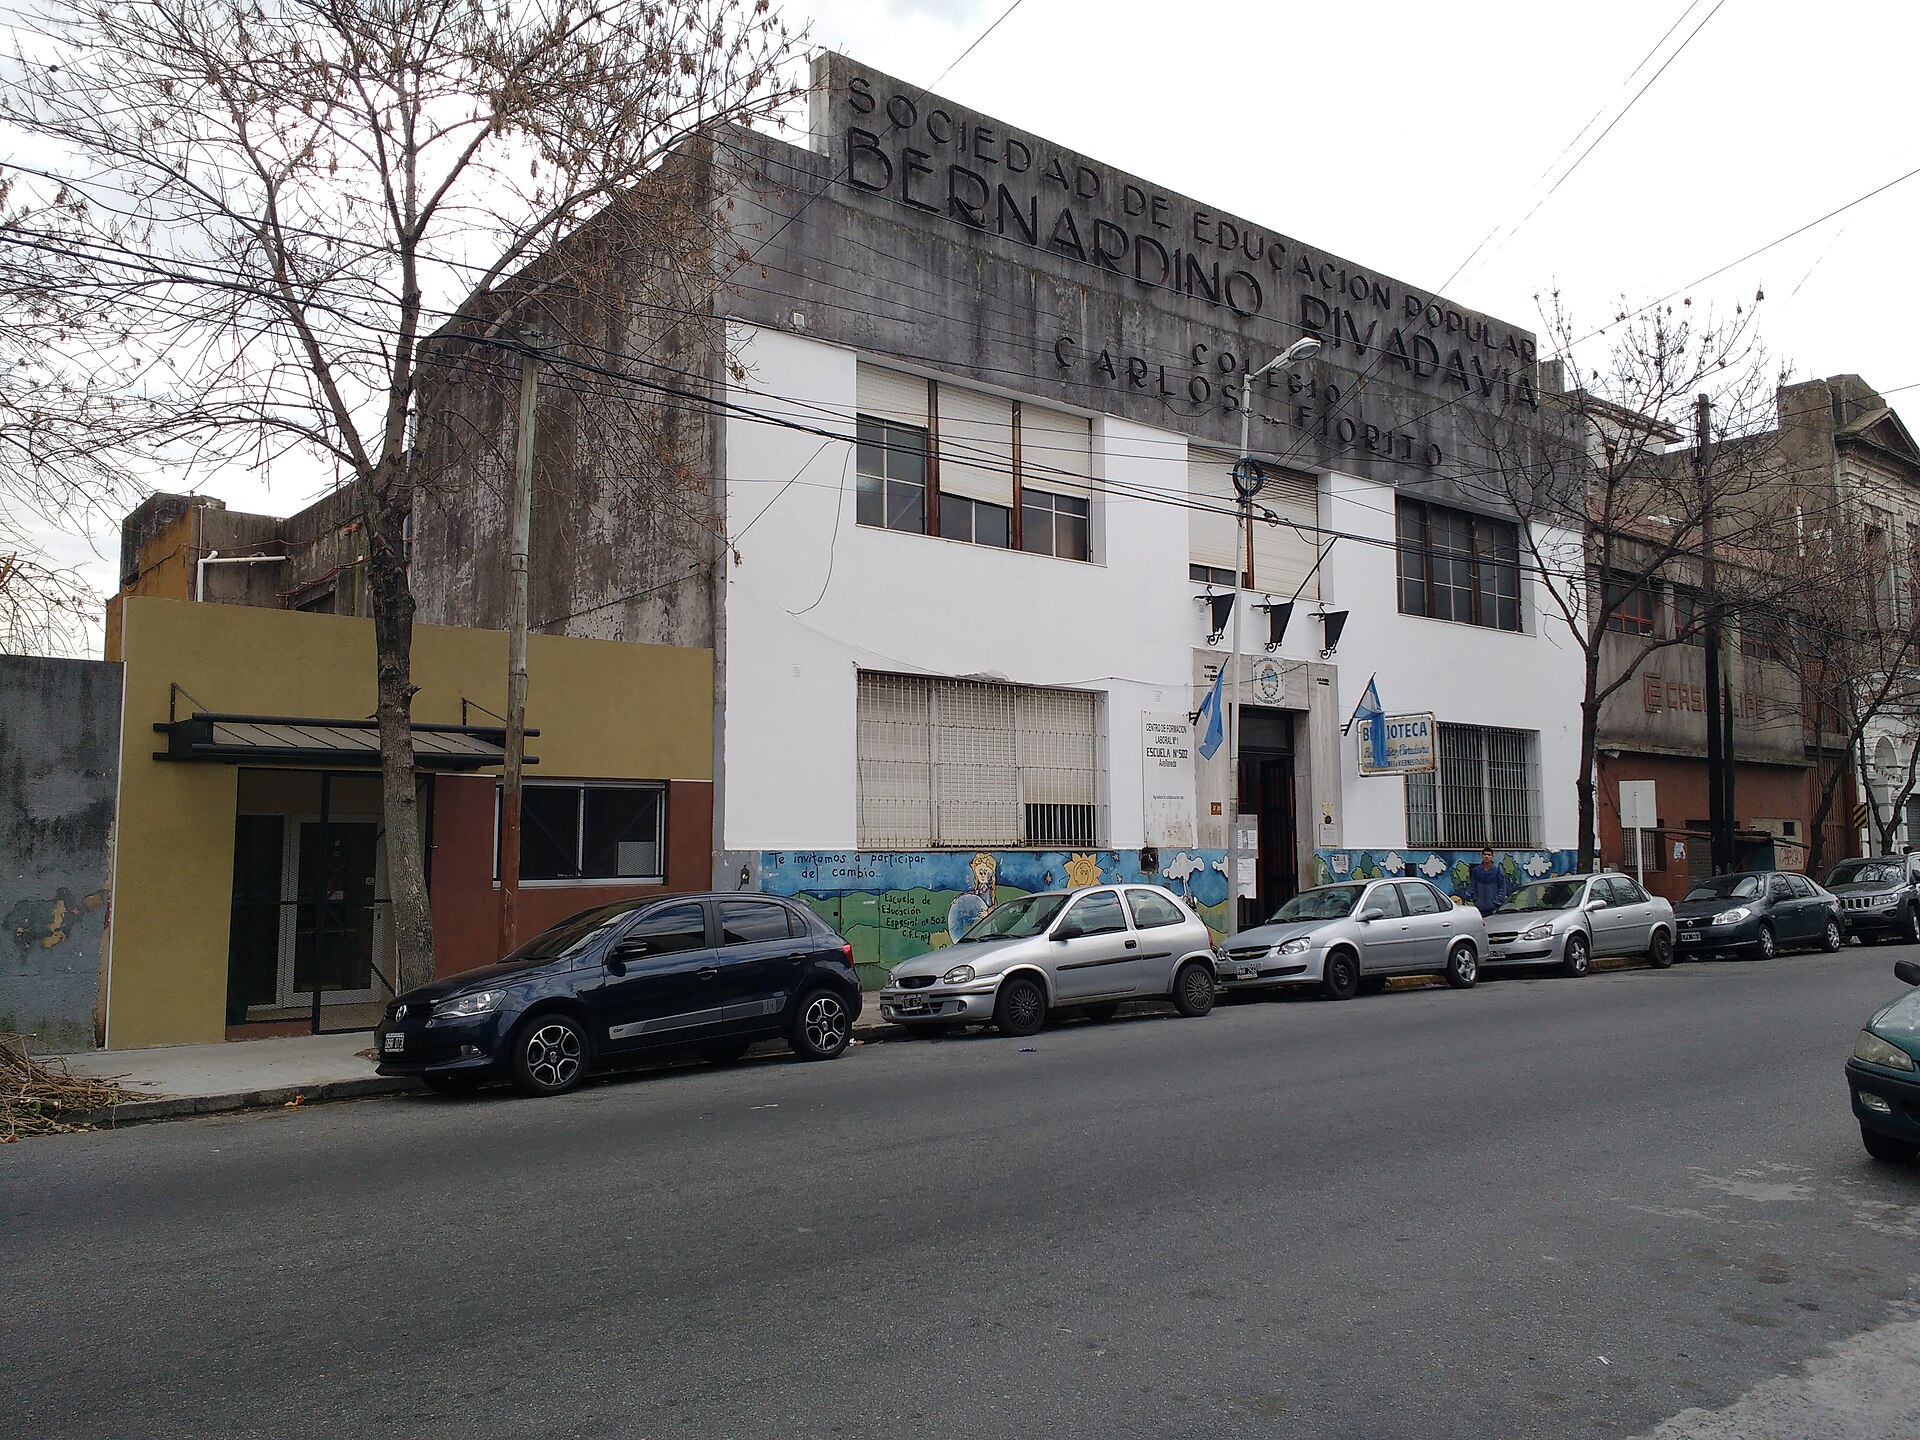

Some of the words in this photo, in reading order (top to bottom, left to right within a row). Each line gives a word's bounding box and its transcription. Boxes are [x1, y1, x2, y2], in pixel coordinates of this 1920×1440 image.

[848, 77, 1101, 199] SOCIEDAD
[1121, 184, 1173, 229] DE
[1193, 210, 1391, 311] EDUCACION
[1405, 294, 1536, 363] POPULAR
[847, 126, 1263, 318] BERNARDINO
[1301, 293, 1539, 413] RIVADAVIA
[1054, 336, 1240, 412] CARLOS
[1296, 404, 1443, 467] FIORITO
[1363, 721, 1428, 741] BIOTECA
[1146, 747, 1171, 758] ESCUELA
[768, 852, 785, 868] Te
[793, 853, 847, 866] invitamos
[870, 853, 926, 868] participar
[802, 866, 819, 882] del
[832, 865, 883, 879] cambio...
[885, 892, 914, 904] Escuela
[922, 895, 931, 905] de
[881, 904, 921, 916] Educación
[886, 916, 917, 929] Especial
[930, 916, 946, 925] 502
